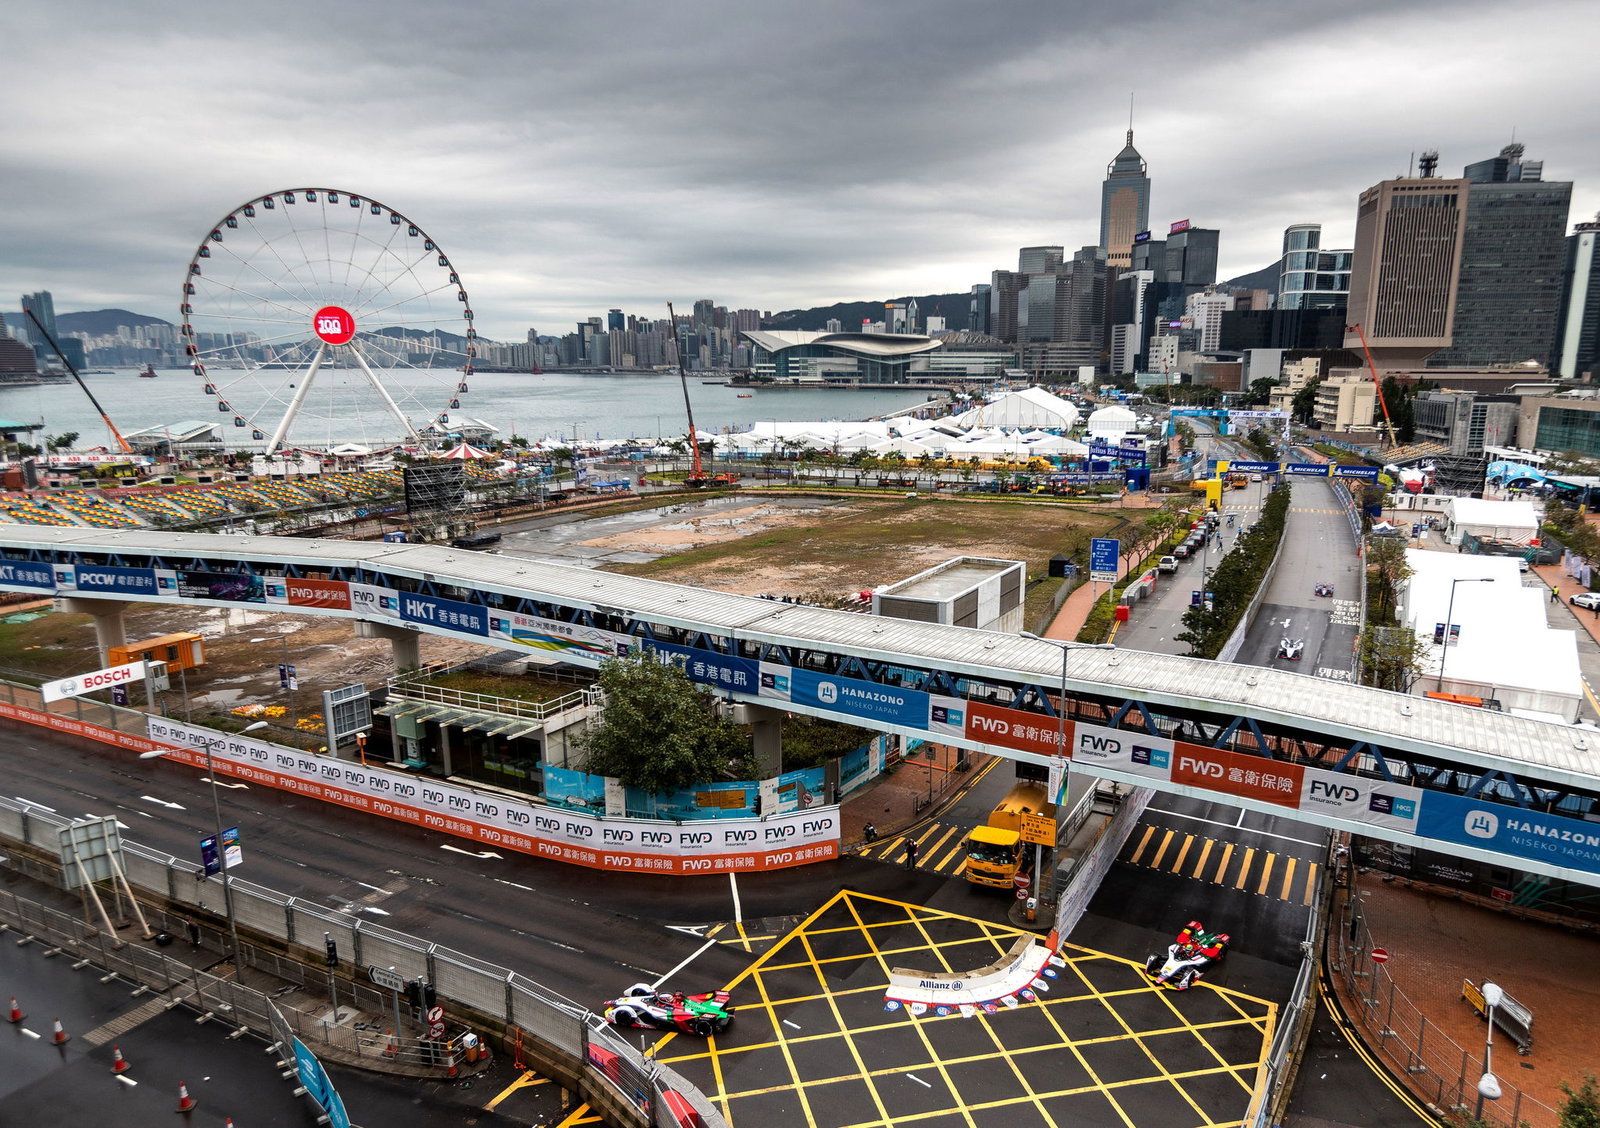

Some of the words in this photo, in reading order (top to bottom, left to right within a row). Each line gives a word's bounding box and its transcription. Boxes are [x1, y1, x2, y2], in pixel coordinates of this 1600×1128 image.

[0, 566, 14, 580] KT
[80, 573, 115, 585] PCCW
[291, 587, 313, 598] FWD
[353, 591, 374, 602] FWD
[406, 599, 437, 620] HKT
[83, 668, 131, 688] BOSCH
[693, 661, 747, 687] 香港電訊
[841, 686, 904, 706] HANAZONO
[845, 700, 873, 711] NISEKO
[875, 706, 899, 716] JAPAN
[152, 724, 167, 735] FWD
[972, 715, 1009, 734] FWD
[170, 728, 185, 740] FWD
[189, 733, 206, 745] FWD
[229, 743, 246, 755] FWD
[1080, 734, 1121, 753] FWD
[250, 748, 268, 760] FWD
[1080, 748, 1107, 758] insurance
[277, 754, 294, 767] FWD
[299, 760, 317, 772] FWD
[237, 766, 253, 777] FWD
[321, 765, 340, 778] FWD
[345, 771, 365, 784] FWD
[1179, 757, 1224, 778] FWD
[1228, 767, 1294, 794] 富衛保險
[280, 777, 297, 789] FWD
[369, 777, 389, 790] FWD
[394, 782, 415, 796] FWD
[324, 789, 342, 801] FWD
[423, 789, 444, 803] FWD
[1310, 780, 1359, 802] FWD
[374, 801, 393, 813] FWD
[449, 795, 470, 809] FWD
[1309, 795, 1342, 807] insurance
[475, 802, 498, 816] FWD
[425, 814, 444, 827] FWD
[506, 809, 530, 823] FWD
[535, 816, 560, 831] FWD
[566, 823, 593, 837] FWD
[803, 818, 832, 833] FWD
[480, 828, 500, 841] FWD
[603, 829, 633, 841] FWD
[641, 832, 672, 844] FWD
[680, 832, 712, 844] FWD
[725, 829, 757, 842] FWD
[765, 825, 795, 840] FWD
[1506, 819, 1600, 847] HANAZON
[538, 842, 562, 856] FWD
[1511, 836, 1557, 851] NISEKO
[1562, 847, 1600, 861] JAPAN
[604, 855, 631, 867] FWD
[765, 852, 792, 866] FWD
[795, 845, 833, 861] 富衛保險
[682, 859, 712, 870] FWD
[714, 857, 755, 869] 富衛保險
[1370, 856, 1411, 870] JAGUAR
[1428, 863, 1473, 878] JAGUAR
[919, 980, 950, 990] Allianz
